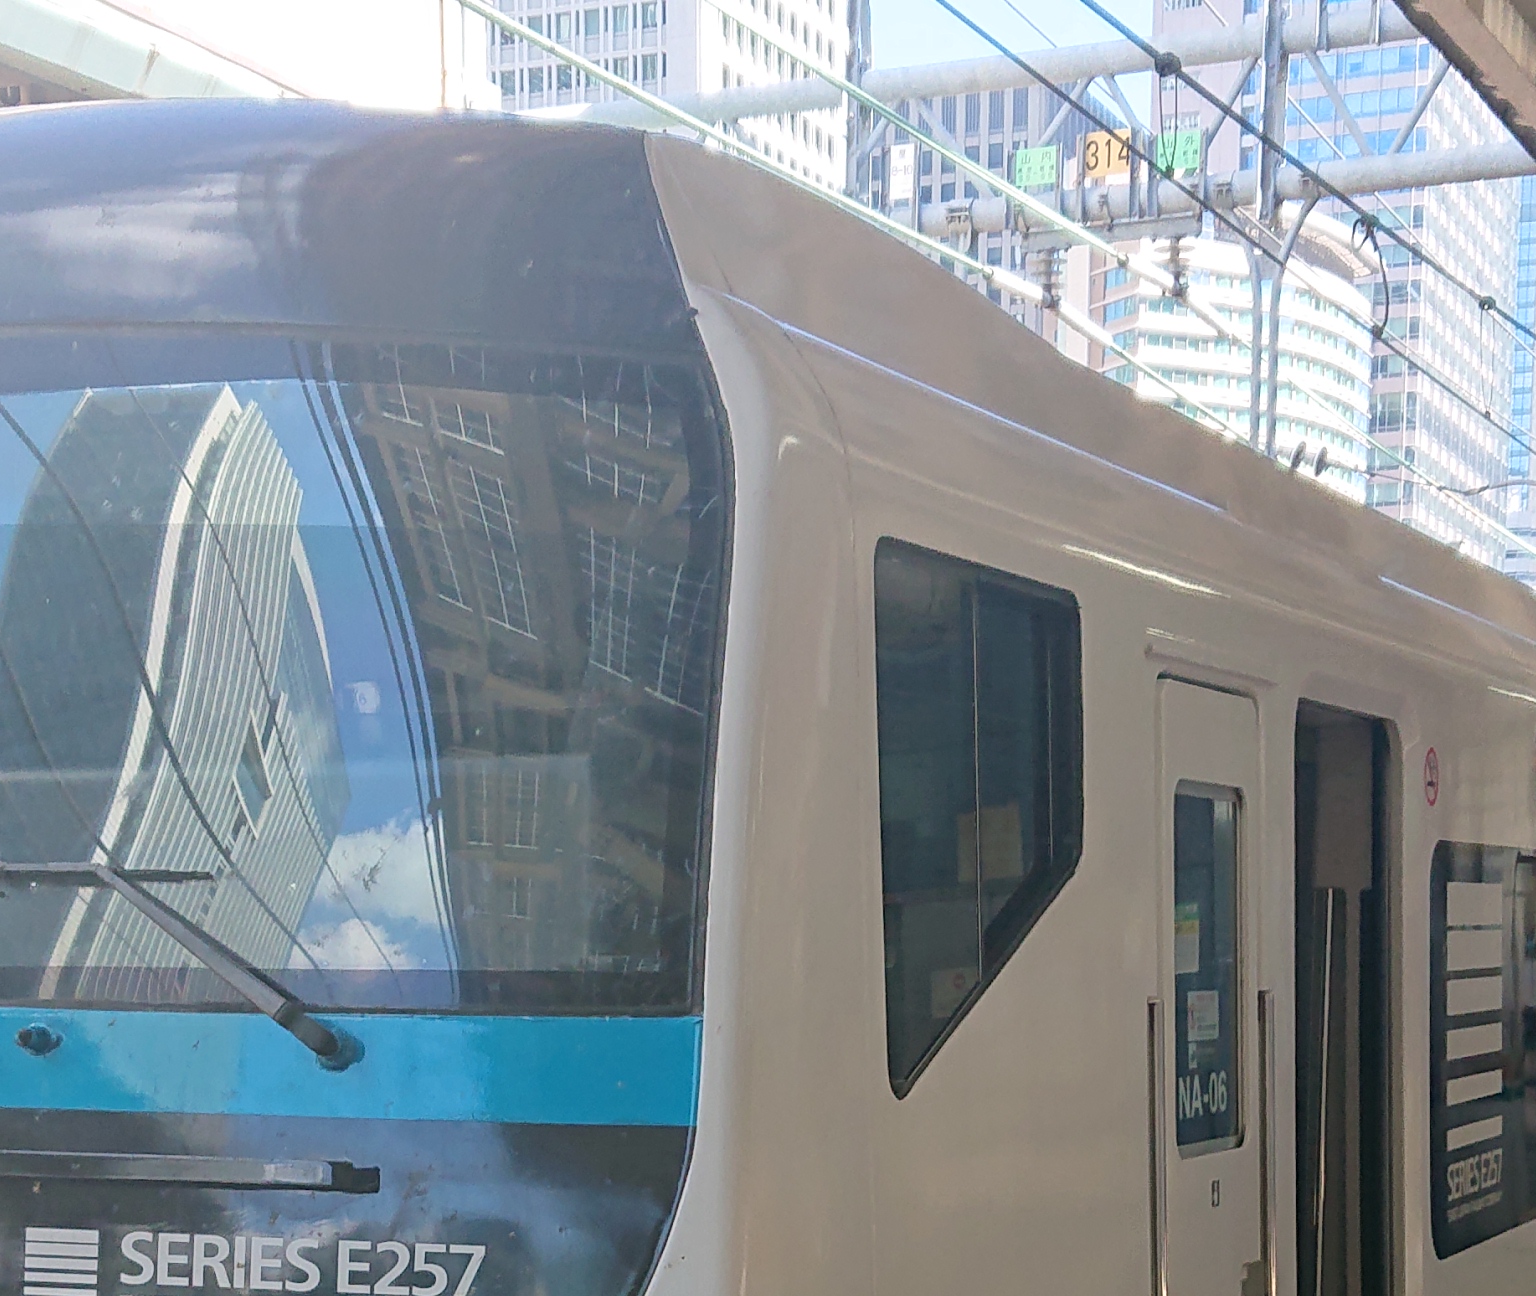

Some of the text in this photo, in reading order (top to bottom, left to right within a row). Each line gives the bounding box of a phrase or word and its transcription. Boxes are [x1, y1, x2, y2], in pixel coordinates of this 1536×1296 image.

[1085, 135, 1131, 171] 314
[1178, 1070, 1227, 1120] NA-06
[1447, 1152, 1480, 1202] SERIES
[119, 1230, 321, 1292] SERIES
